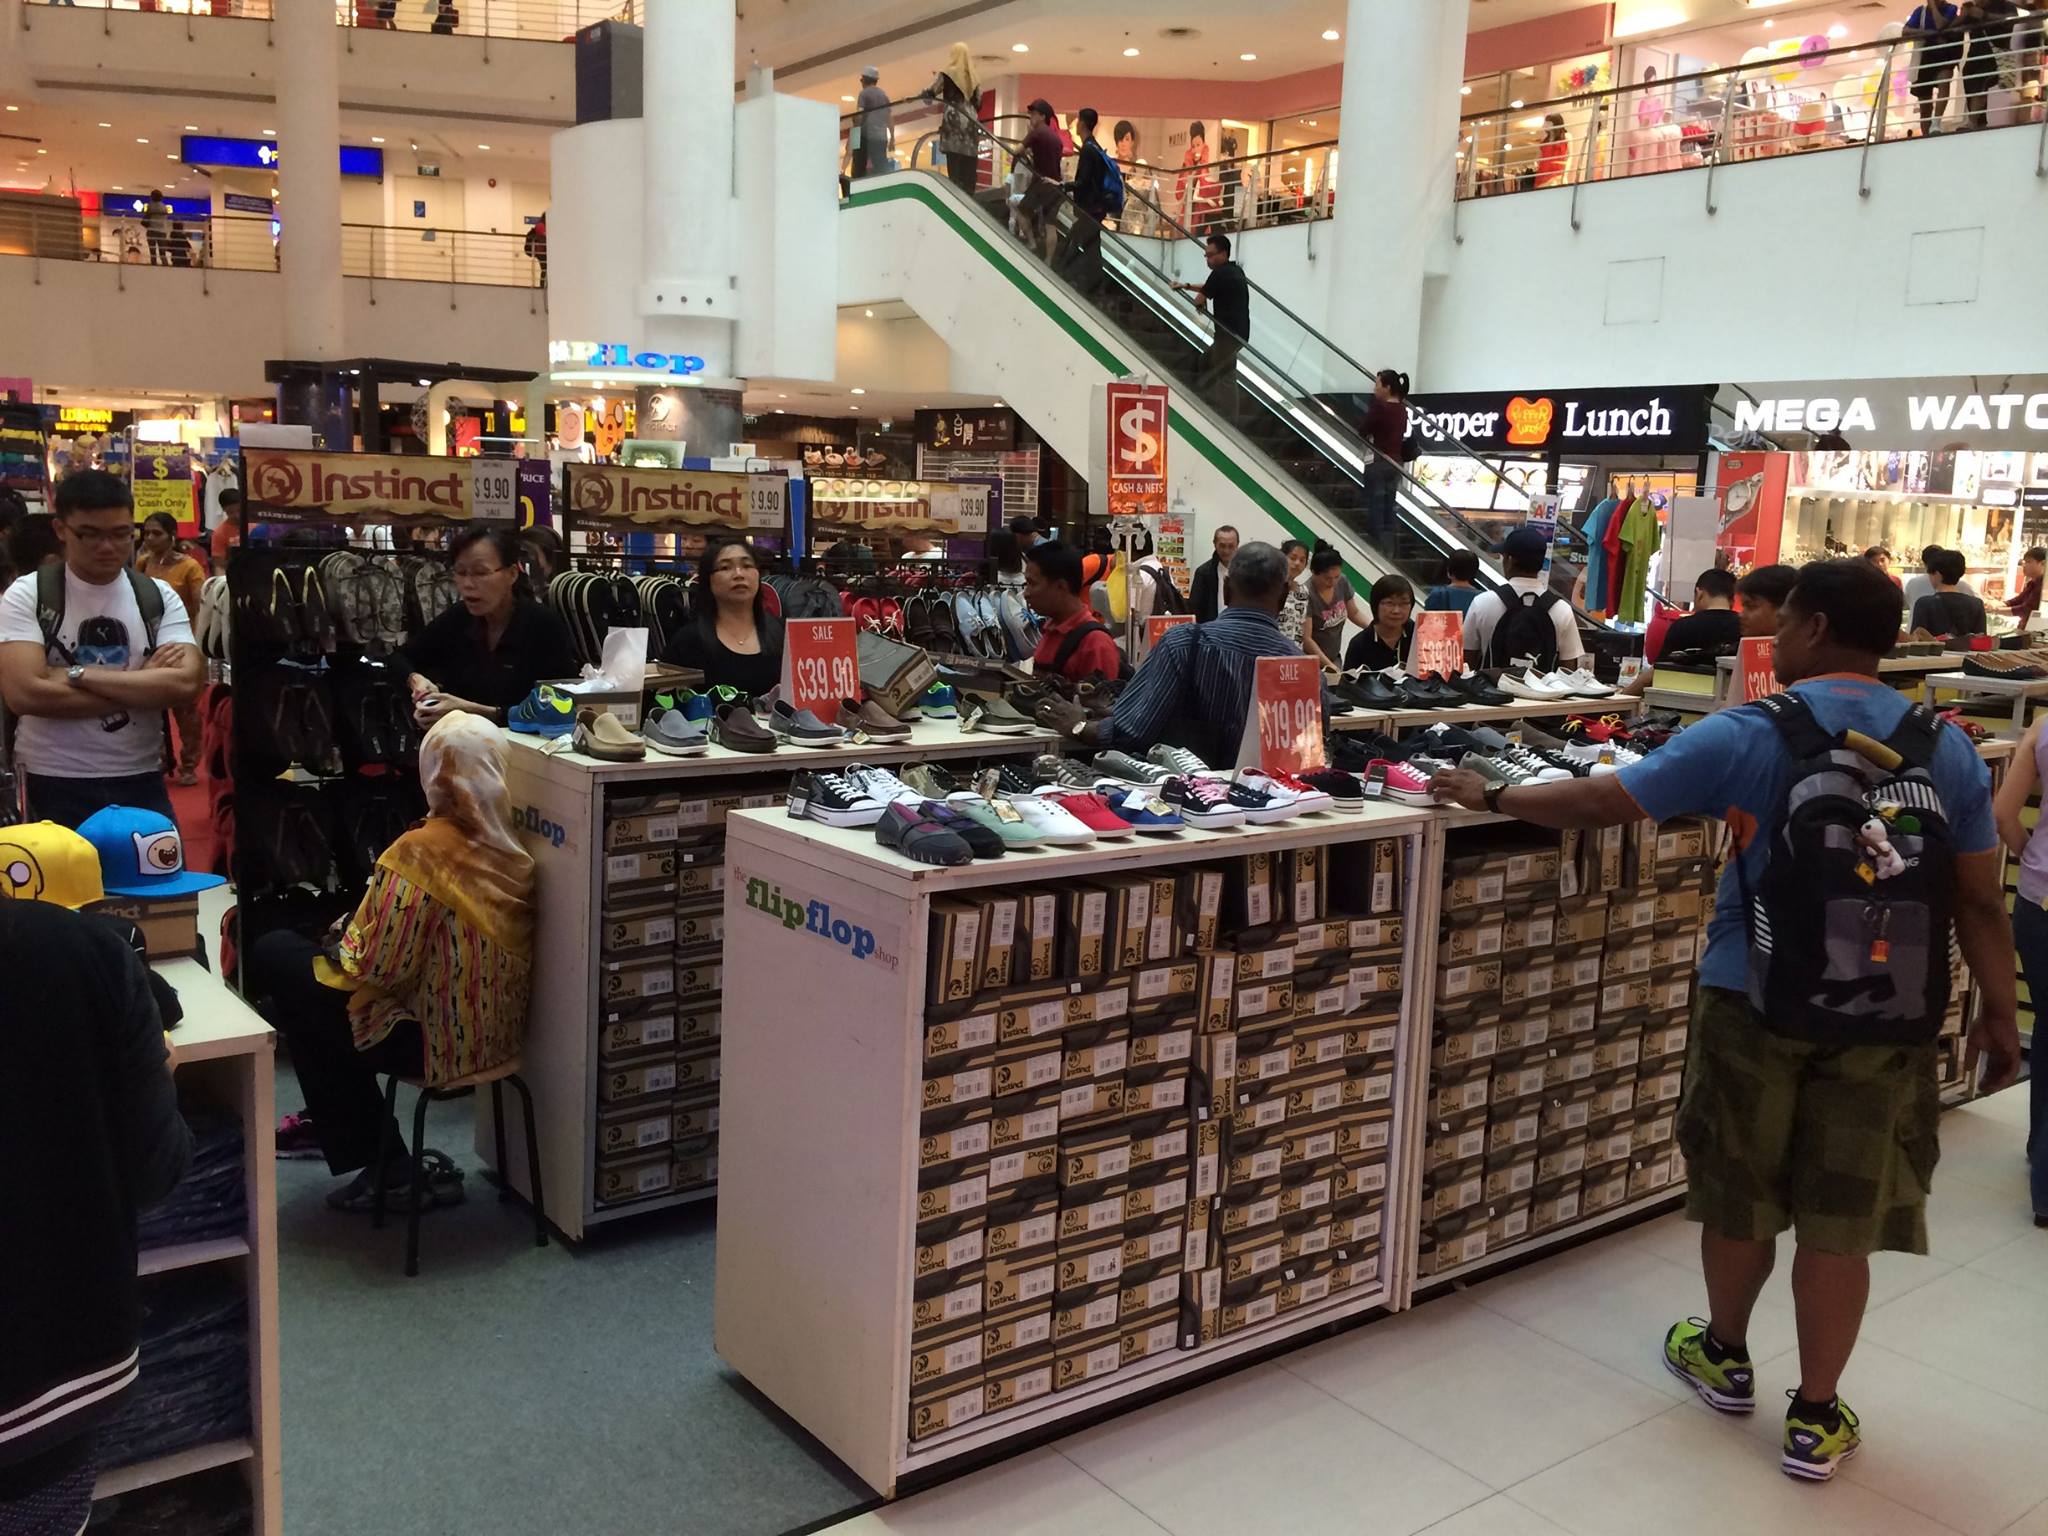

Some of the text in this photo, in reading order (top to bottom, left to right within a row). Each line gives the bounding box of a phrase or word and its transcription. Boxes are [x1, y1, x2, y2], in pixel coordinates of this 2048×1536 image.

[1404, 398, 1672, 441] Pepper Lunch
[1734, 397, 1876, 431] MEGA
[1120, 402, 1158, 470] $
[153, 457, 168, 480] $
[312, 463, 463, 508] Instinct
[138, 498, 186, 509] Cash Only
[621, 477, 743, 519] Instinct
[1113, 483, 1163, 493] CASH & NETS
[960, 498, 984, 517] $39.90
[812, 626, 833, 640] SALE
[798, 656, 855, 702] $39.90
[1279, 663, 1299, 681] SALE
[1264, 698, 1316, 751] $19.90
[734, 867, 747, 883] the
[875, 947, 899, 970] shop
